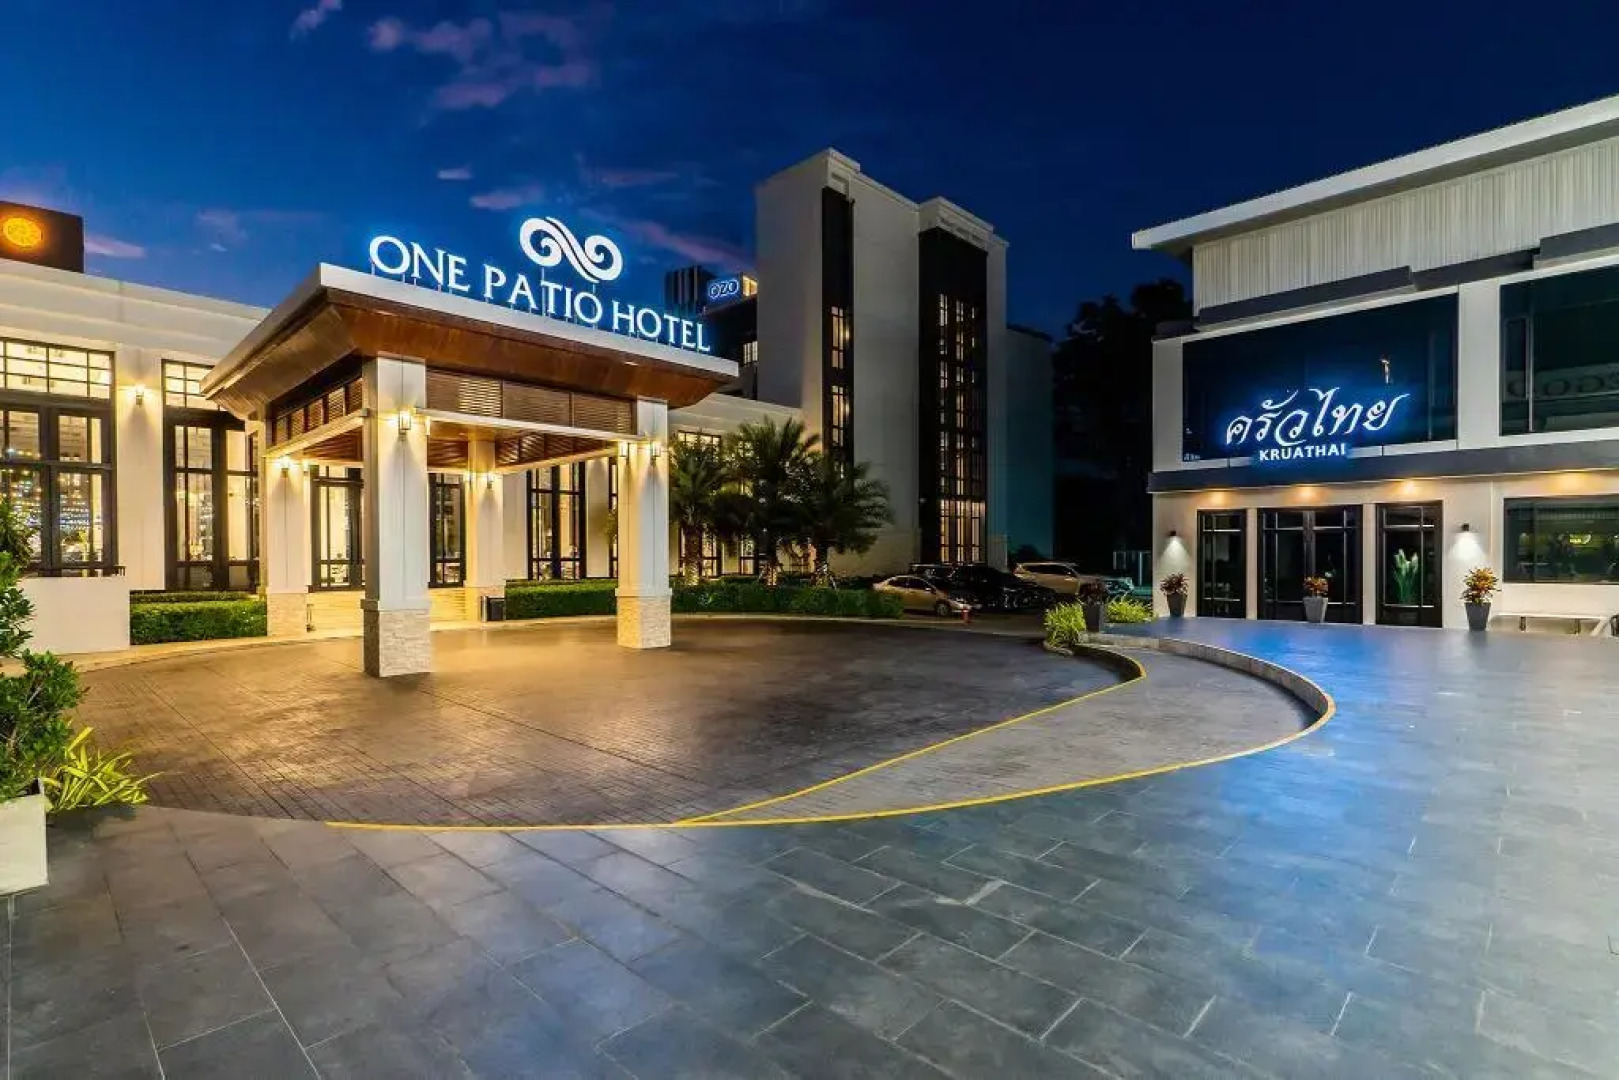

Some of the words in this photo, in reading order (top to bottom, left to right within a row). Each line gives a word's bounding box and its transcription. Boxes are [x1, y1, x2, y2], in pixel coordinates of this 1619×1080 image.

[369, 235, 471, 292] ONE
[483, 263, 602, 324] PATIO
[612, 299, 711, 352] HOTEL
[1226, 386, 1410, 446] ครัวไทย
[1259, 443, 1345, 461] KRUATHAI
